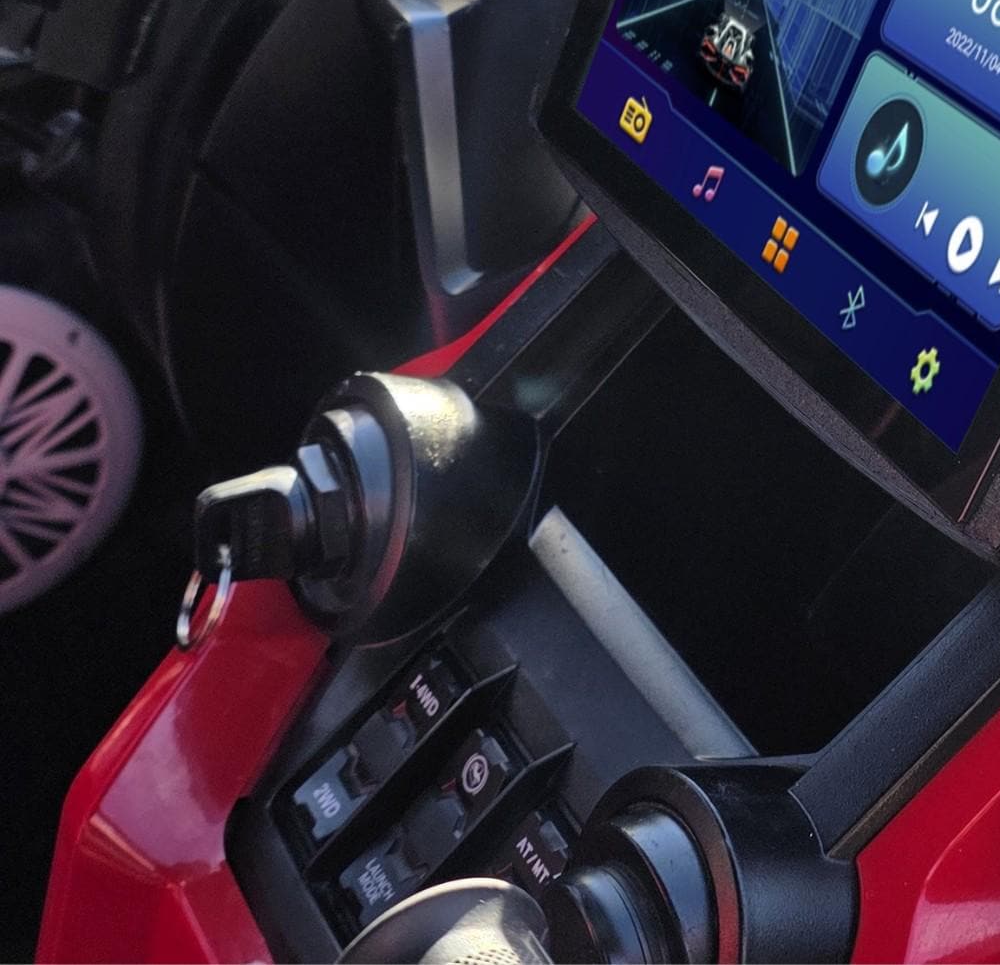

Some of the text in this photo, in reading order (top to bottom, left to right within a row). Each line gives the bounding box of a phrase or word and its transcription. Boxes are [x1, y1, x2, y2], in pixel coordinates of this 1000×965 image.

[313, 783, 341, 818] 2WD
[357, 871, 381, 906] MODE
[365, 857, 396, 902] LAUNCH
